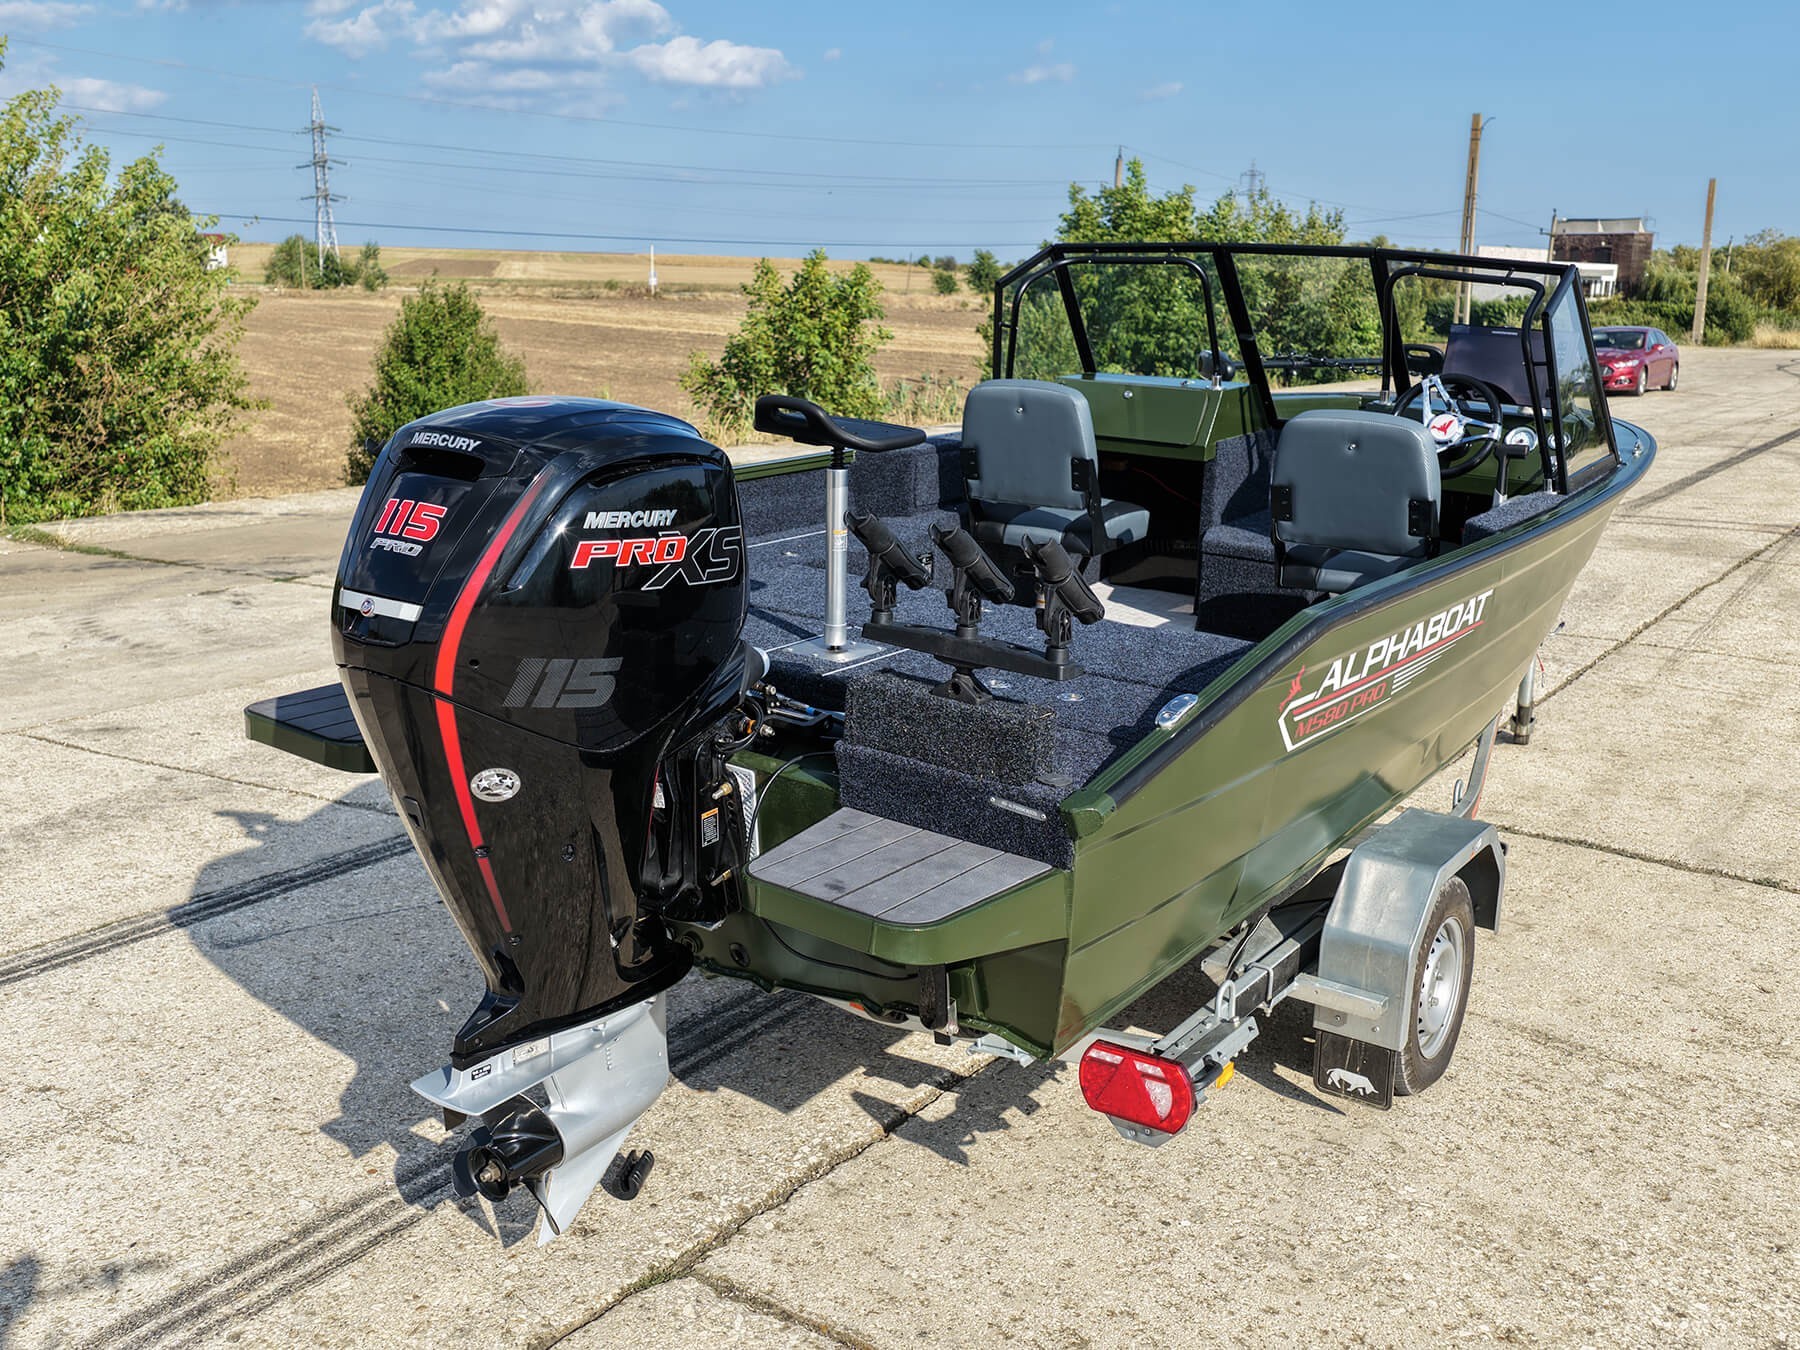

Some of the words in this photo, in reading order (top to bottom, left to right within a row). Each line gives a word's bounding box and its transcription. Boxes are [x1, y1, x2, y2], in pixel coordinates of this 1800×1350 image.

[410, 432, 482, 452] MERCURY
[374, 498, 448, 542] 115
[583, 509, 677, 529] MERCURY
[370, 537, 423, 557] PRO
[570, 536, 688, 568] PRO
[1315, 589, 1494, 700] ALPHABOAT
[502, 657, 623, 709] 115
[1295, 701, 1349, 738] M580
[1350, 682, 1387, 713] PRO
